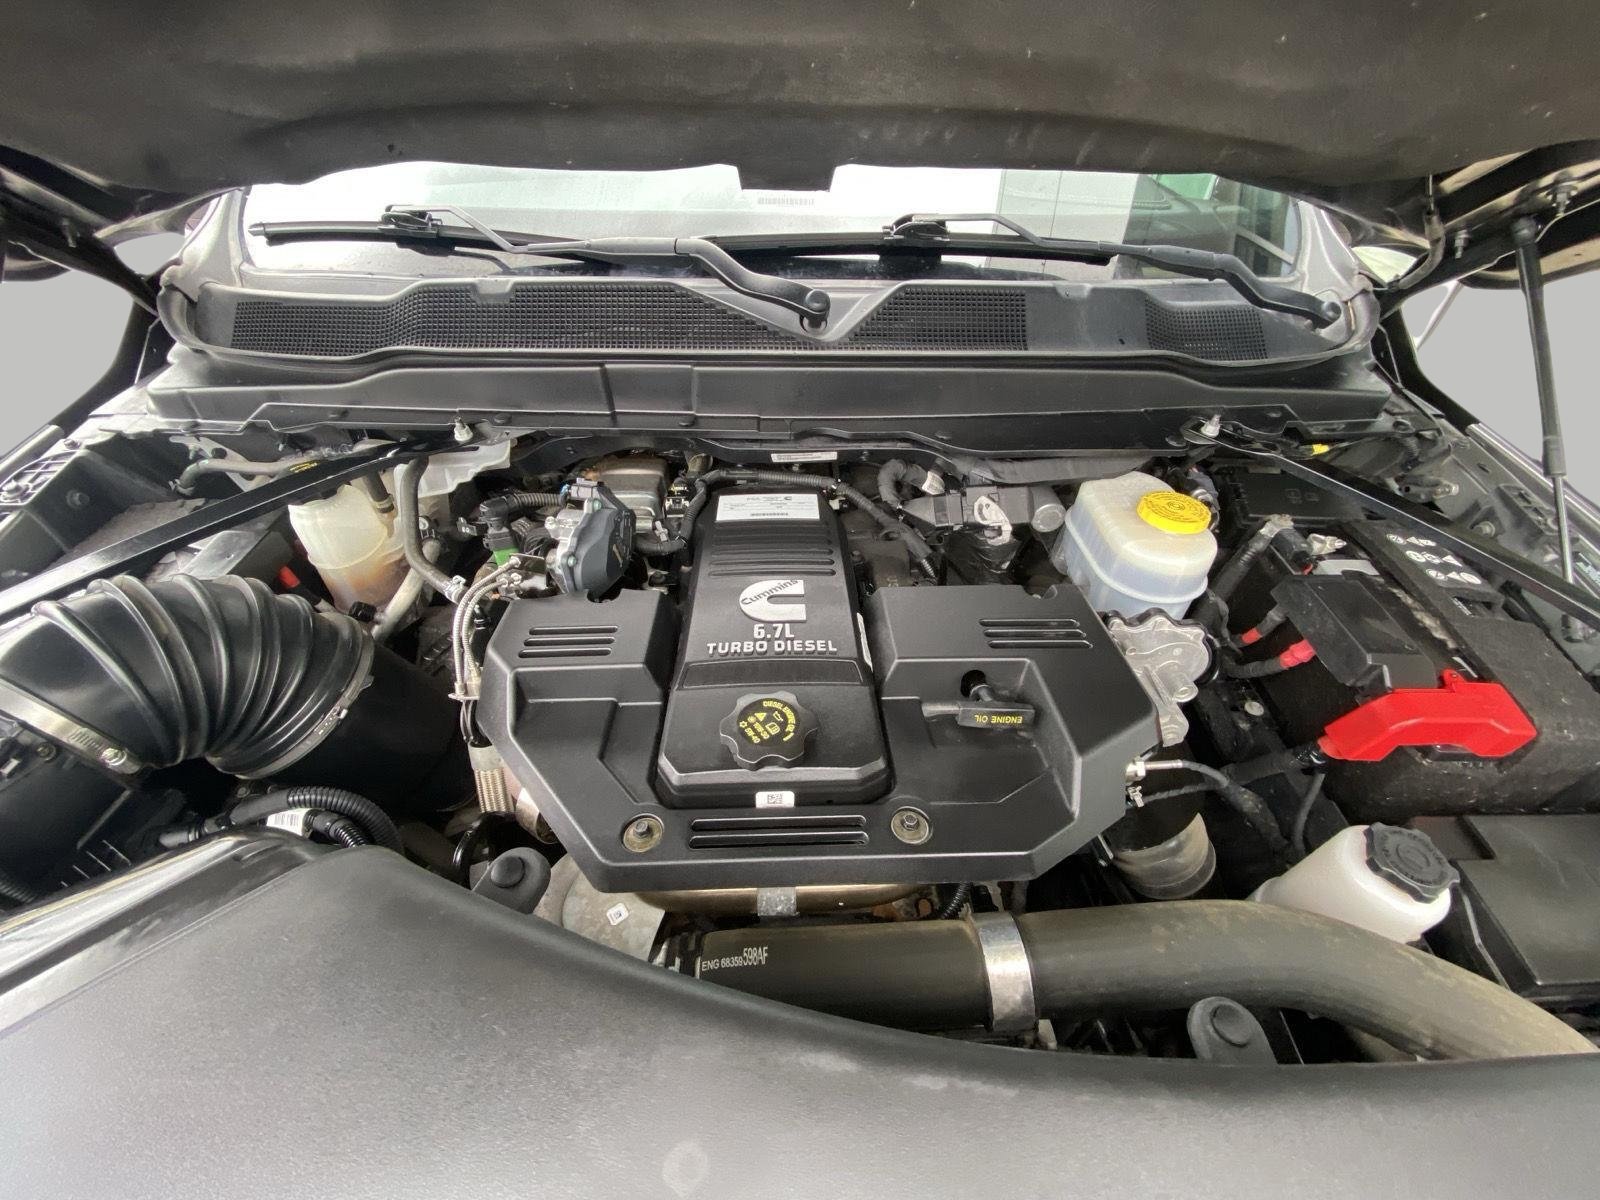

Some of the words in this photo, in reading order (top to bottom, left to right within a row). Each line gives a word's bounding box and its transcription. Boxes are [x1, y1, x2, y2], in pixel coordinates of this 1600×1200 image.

[740, 579, 799, 605] Cummins
[753, 623, 795, 639] 6.7L
[707, 641, 767, 653] TURBO
[775, 640, 837, 652] DIESEL
[974, 715, 988, 723] OIL
[990, 715, 1022, 723] ENGINE
[701, 959, 720, 971] ENG
